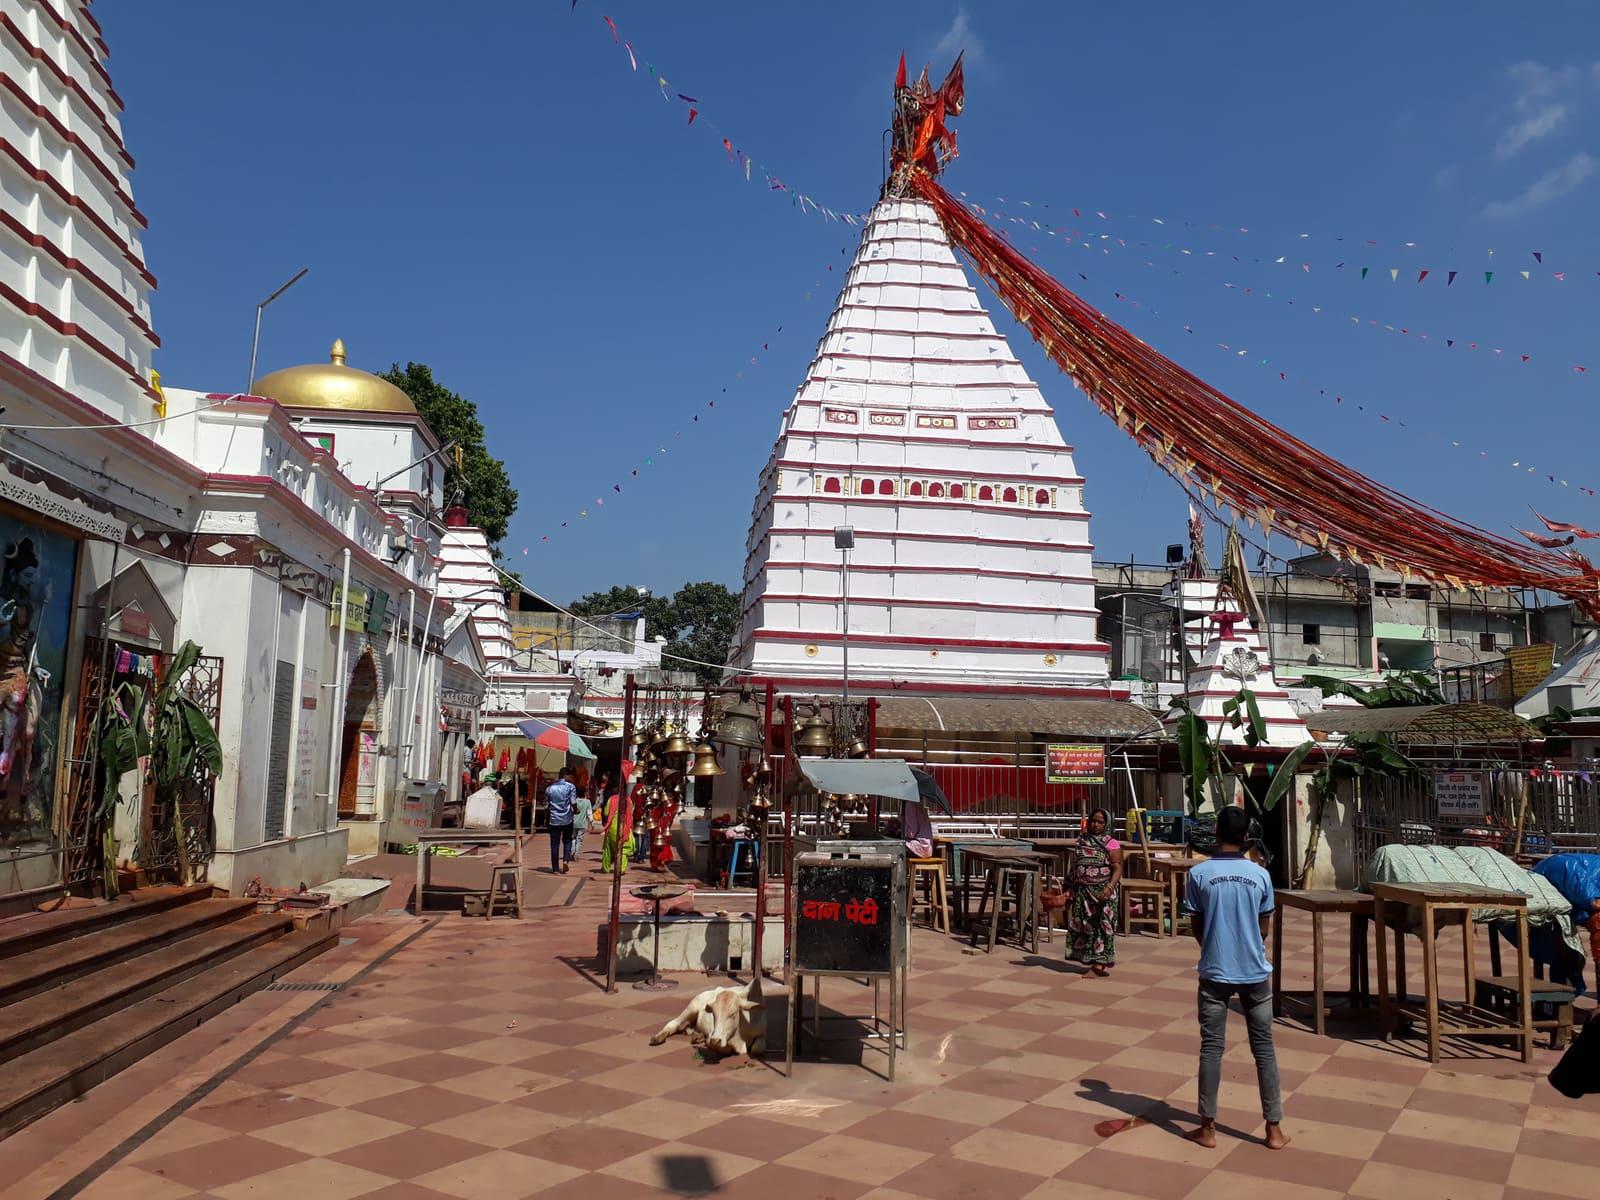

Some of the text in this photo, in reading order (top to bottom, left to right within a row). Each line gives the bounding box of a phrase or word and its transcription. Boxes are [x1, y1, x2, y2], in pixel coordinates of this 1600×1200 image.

[1209, 876, 1229, 885] NATIONAL
[1243, 877, 1257, 888] CORPS
[802, 897, 879, 924] दान पेटी
